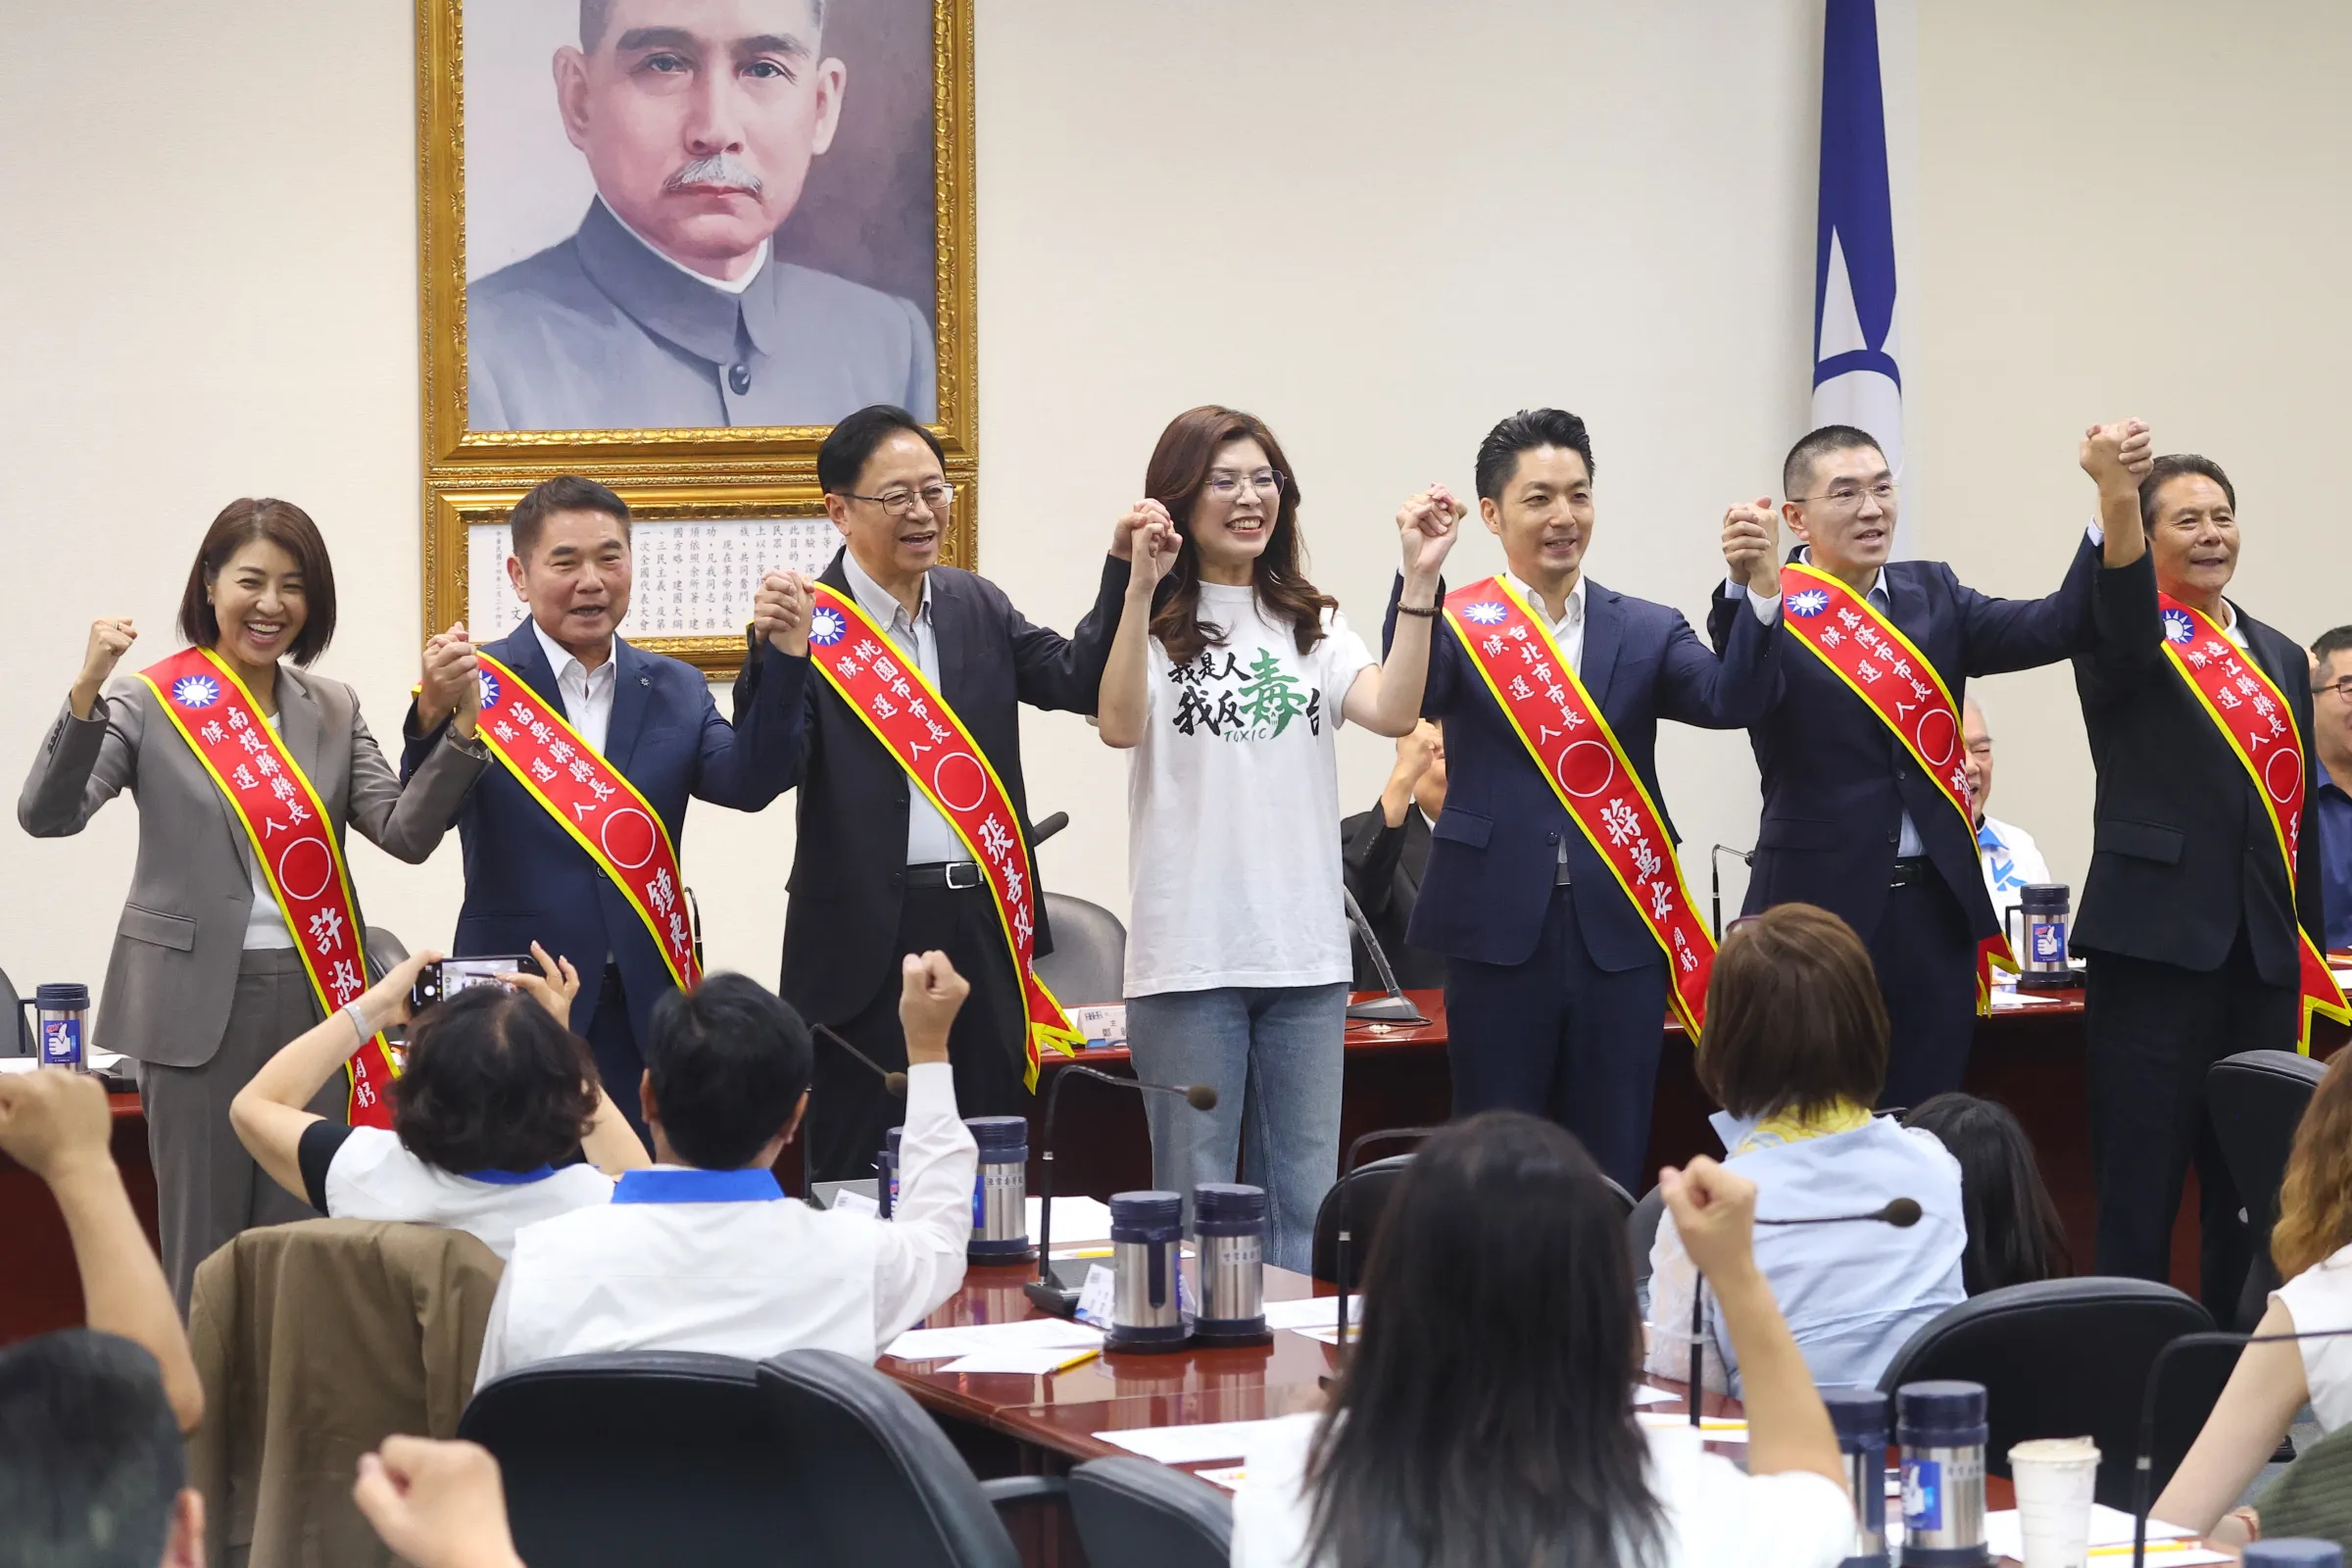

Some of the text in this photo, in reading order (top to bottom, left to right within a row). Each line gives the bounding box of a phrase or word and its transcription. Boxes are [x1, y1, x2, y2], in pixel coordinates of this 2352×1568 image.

[853, 637, 953, 746] 桃園市市長
[1167, 652, 1251, 686] 我是人
[1482, 633, 1561, 745] 候選人
[1507, 624, 1586, 731] 台北市市長
[1819, 625, 1917, 722] 候選人
[1837, 607, 1932, 704] 基隆市市長
[2186, 651, 2271, 752] 候選人
[2207, 640, 2287, 740] 連江縣縣長
[509, 701, 616, 803] 苗栗縣縣長
[836, 656, 932, 762] 候選人
[1224, 727, 1267, 743] TOXIC
[201, 719, 287, 838] 候選人
[227, 706, 312, 826] 南投縣縣長
[493, 719, 596, 821] 候選人
[977, 812, 1033, 950] 張善政
